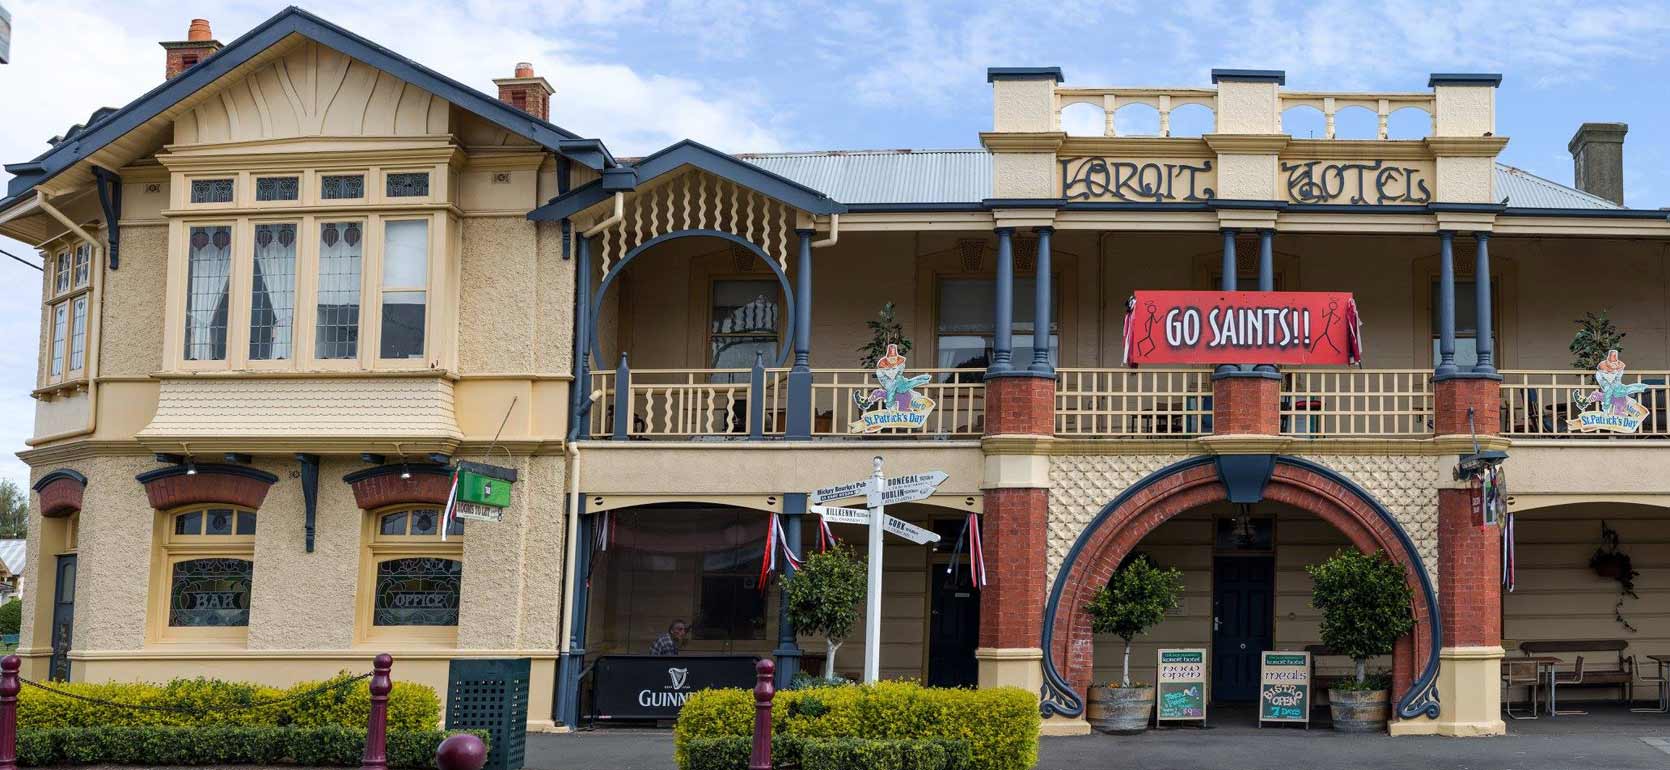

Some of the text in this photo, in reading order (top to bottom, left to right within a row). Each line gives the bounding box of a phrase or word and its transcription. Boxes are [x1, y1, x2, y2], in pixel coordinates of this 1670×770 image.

[1062, 157, 1431, 205] KOROIT HOTEL
[1165, 308, 1311, 347] GO SAINTS!!
[909, 412, 926, 424] Day
[1623, 415, 1638, 430] Day
[881, 489, 905, 500] DUBLIN
[826, 507, 857, 517] KILLKENNY
[888, 518, 906, 531] CORK
[195, 593, 234, 609] BAR
[394, 593, 448, 607] OFFICE
[1264, 669, 1307, 680] meals
[1264, 684, 1303, 700] BISTRO
[1272, 695, 1297, 706] OPEN
[1271, 706, 1302, 718] 7 DAYS
